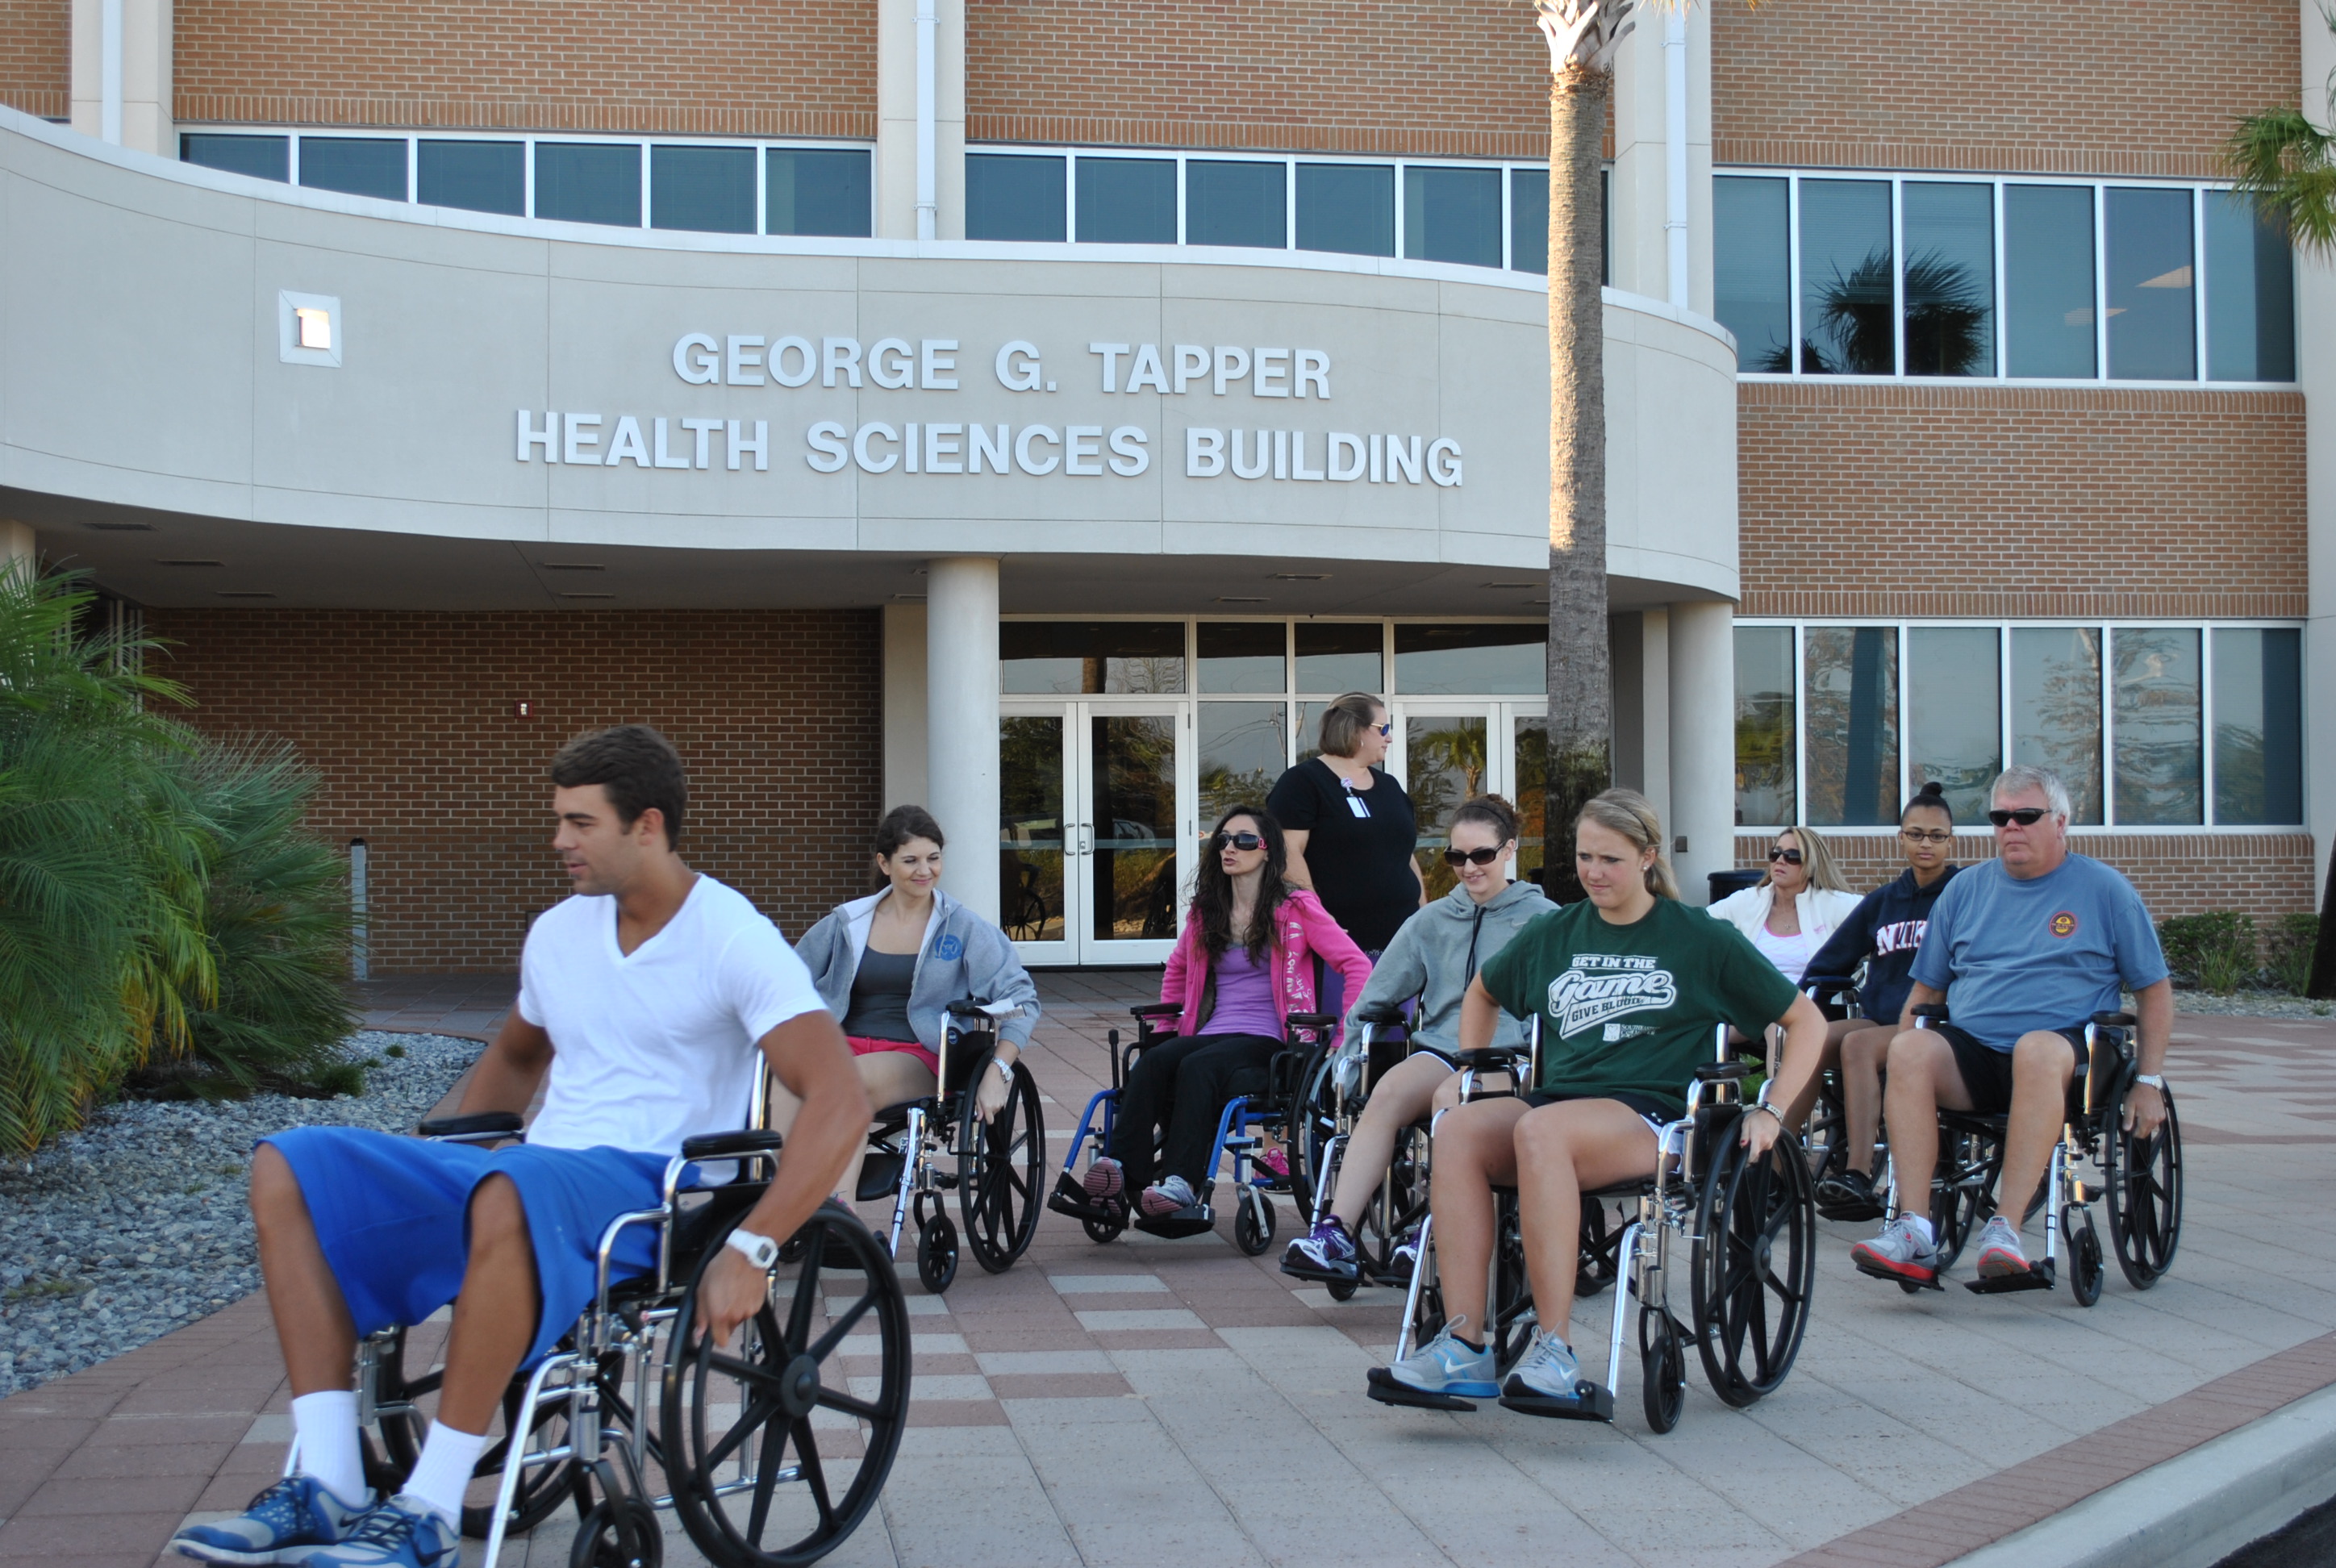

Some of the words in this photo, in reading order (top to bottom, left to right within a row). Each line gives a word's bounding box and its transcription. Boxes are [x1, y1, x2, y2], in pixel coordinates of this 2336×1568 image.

[673, 332, 960, 390] GEORGE
[995, 340, 1057, 392] G.
[1089, 341, 1331, 400] TAPPER
[515, 408, 769, 471] HEALTH
[805, 419, 1150, 477] SCIENCES
[1186, 427, 1463, 487] BUILDING
[1572, 956, 1601, 967] GET
[1601, 957, 1621, 968] IN
[1623, 957, 1656, 969] THE
[1549, 972, 1674, 1014] Game
[1571, 1004, 1599, 1022] GIVE
